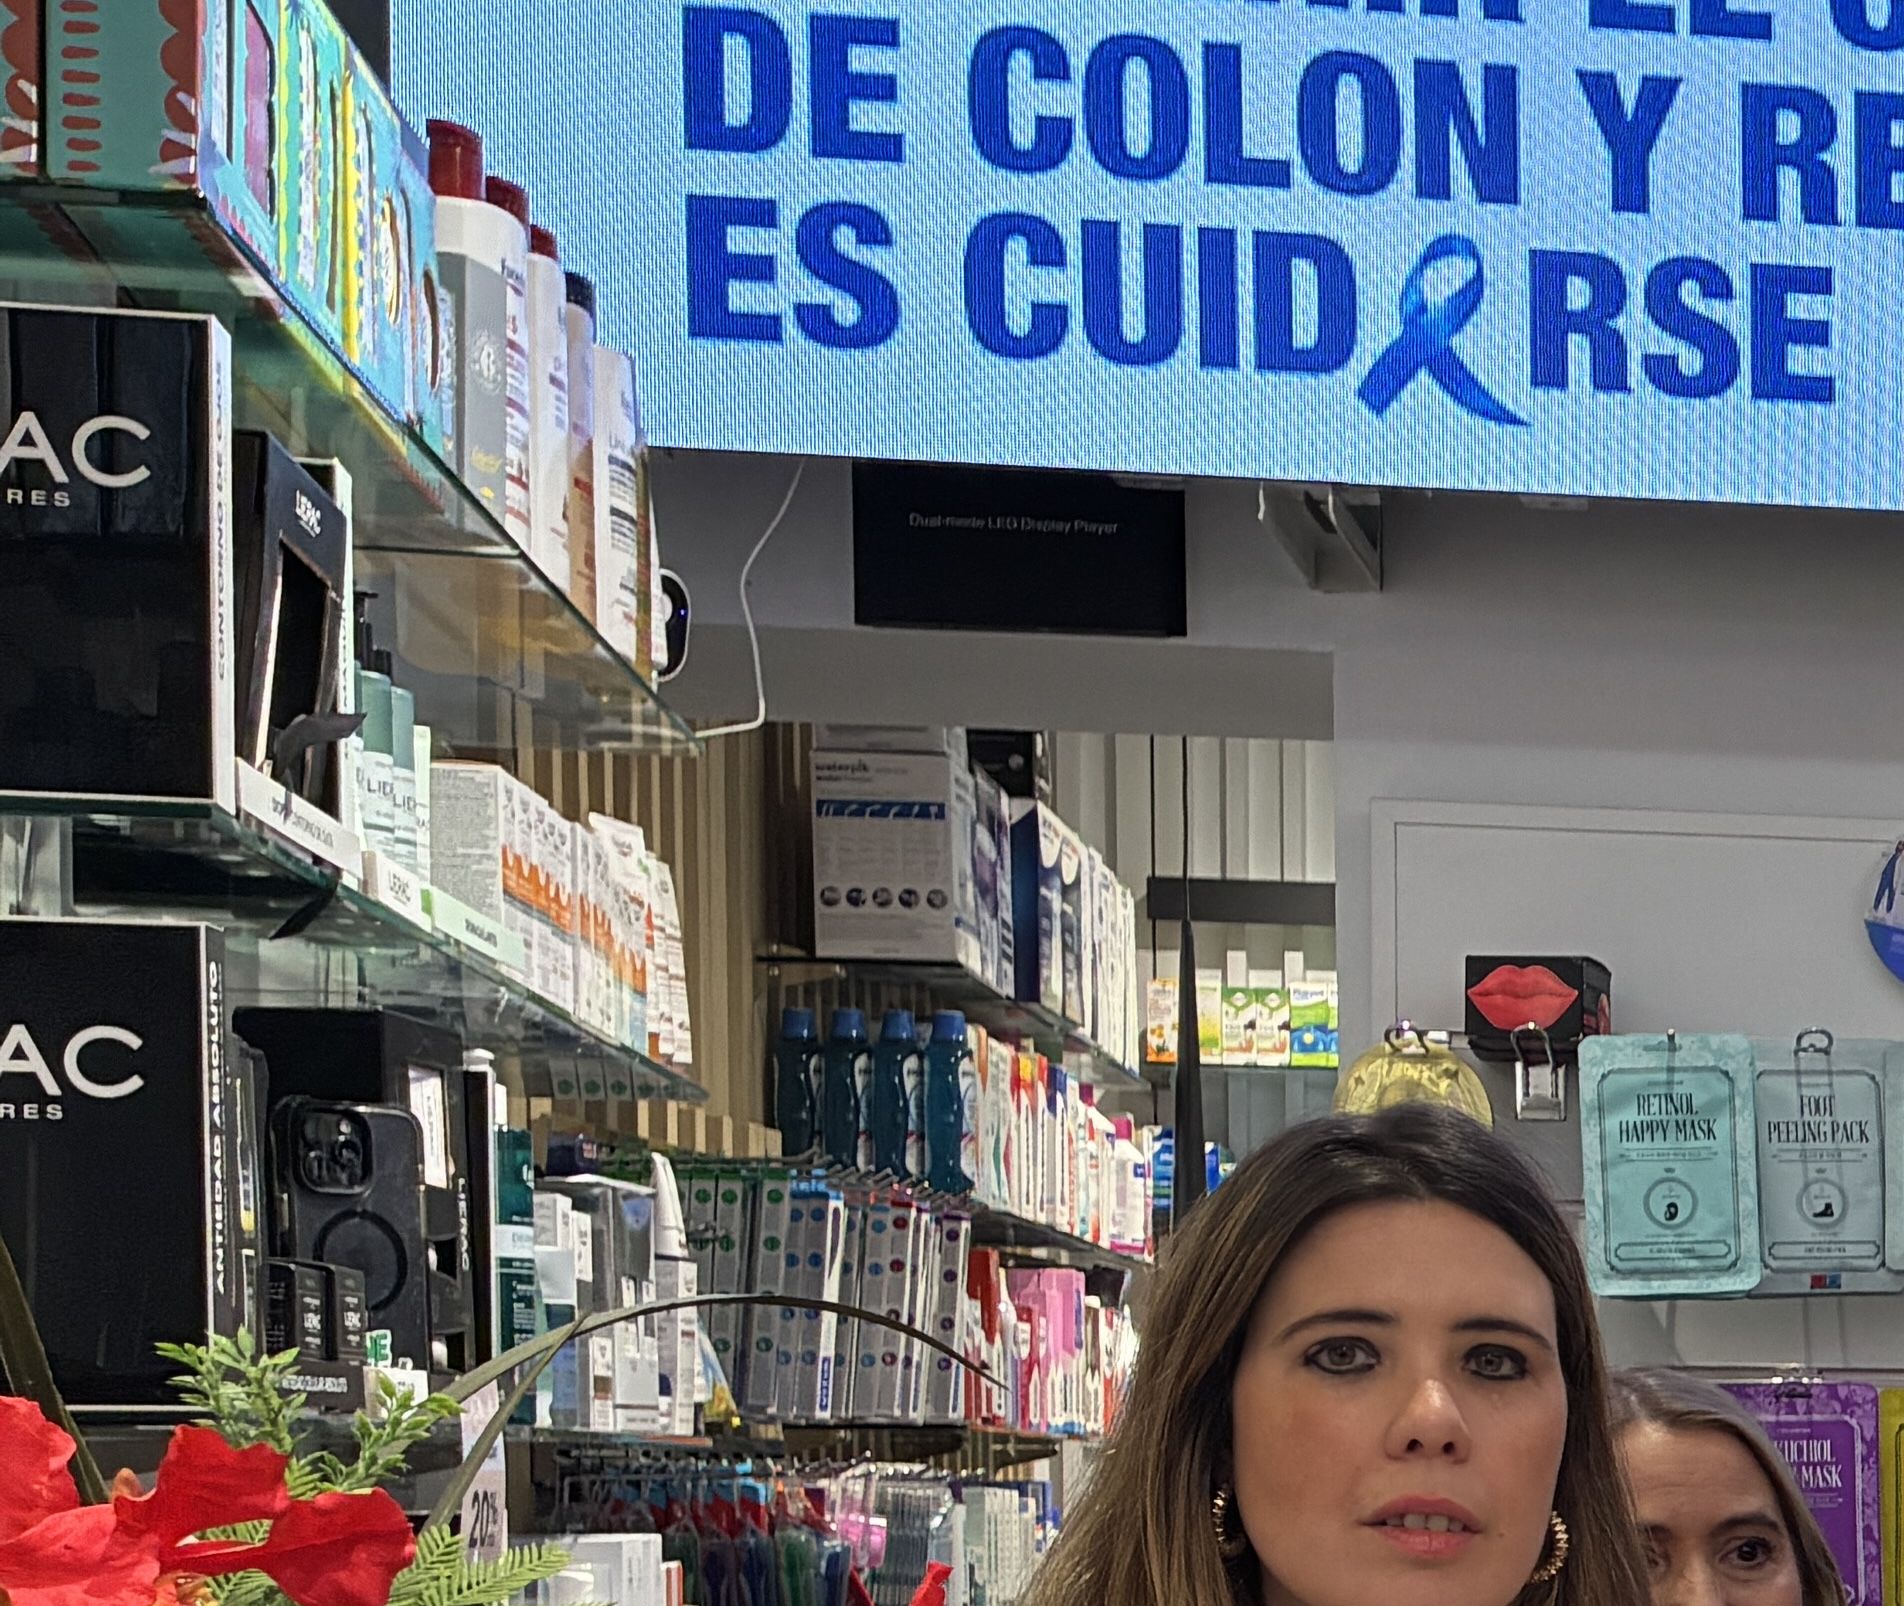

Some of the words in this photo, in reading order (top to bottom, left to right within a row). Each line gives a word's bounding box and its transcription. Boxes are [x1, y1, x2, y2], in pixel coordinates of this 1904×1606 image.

[683, 6, 905, 164] DE
[966, 24, 1520, 205] COLON
[1577, 70, 1682, 214] Y
[685, 194, 900, 350] ES
[1636, 1093, 1699, 1116] RETINOL
[1799, 1094, 1835, 1117] FOOT
[1618, 1119, 1671, 1144] HAPPY
[1674, 1118, 1718, 1142] MASK
[1767, 1120, 1828, 1144] PEELING
[1831, 1120, 1870, 1144] PACK
[1801, 1464, 1842, 1488] MASK
